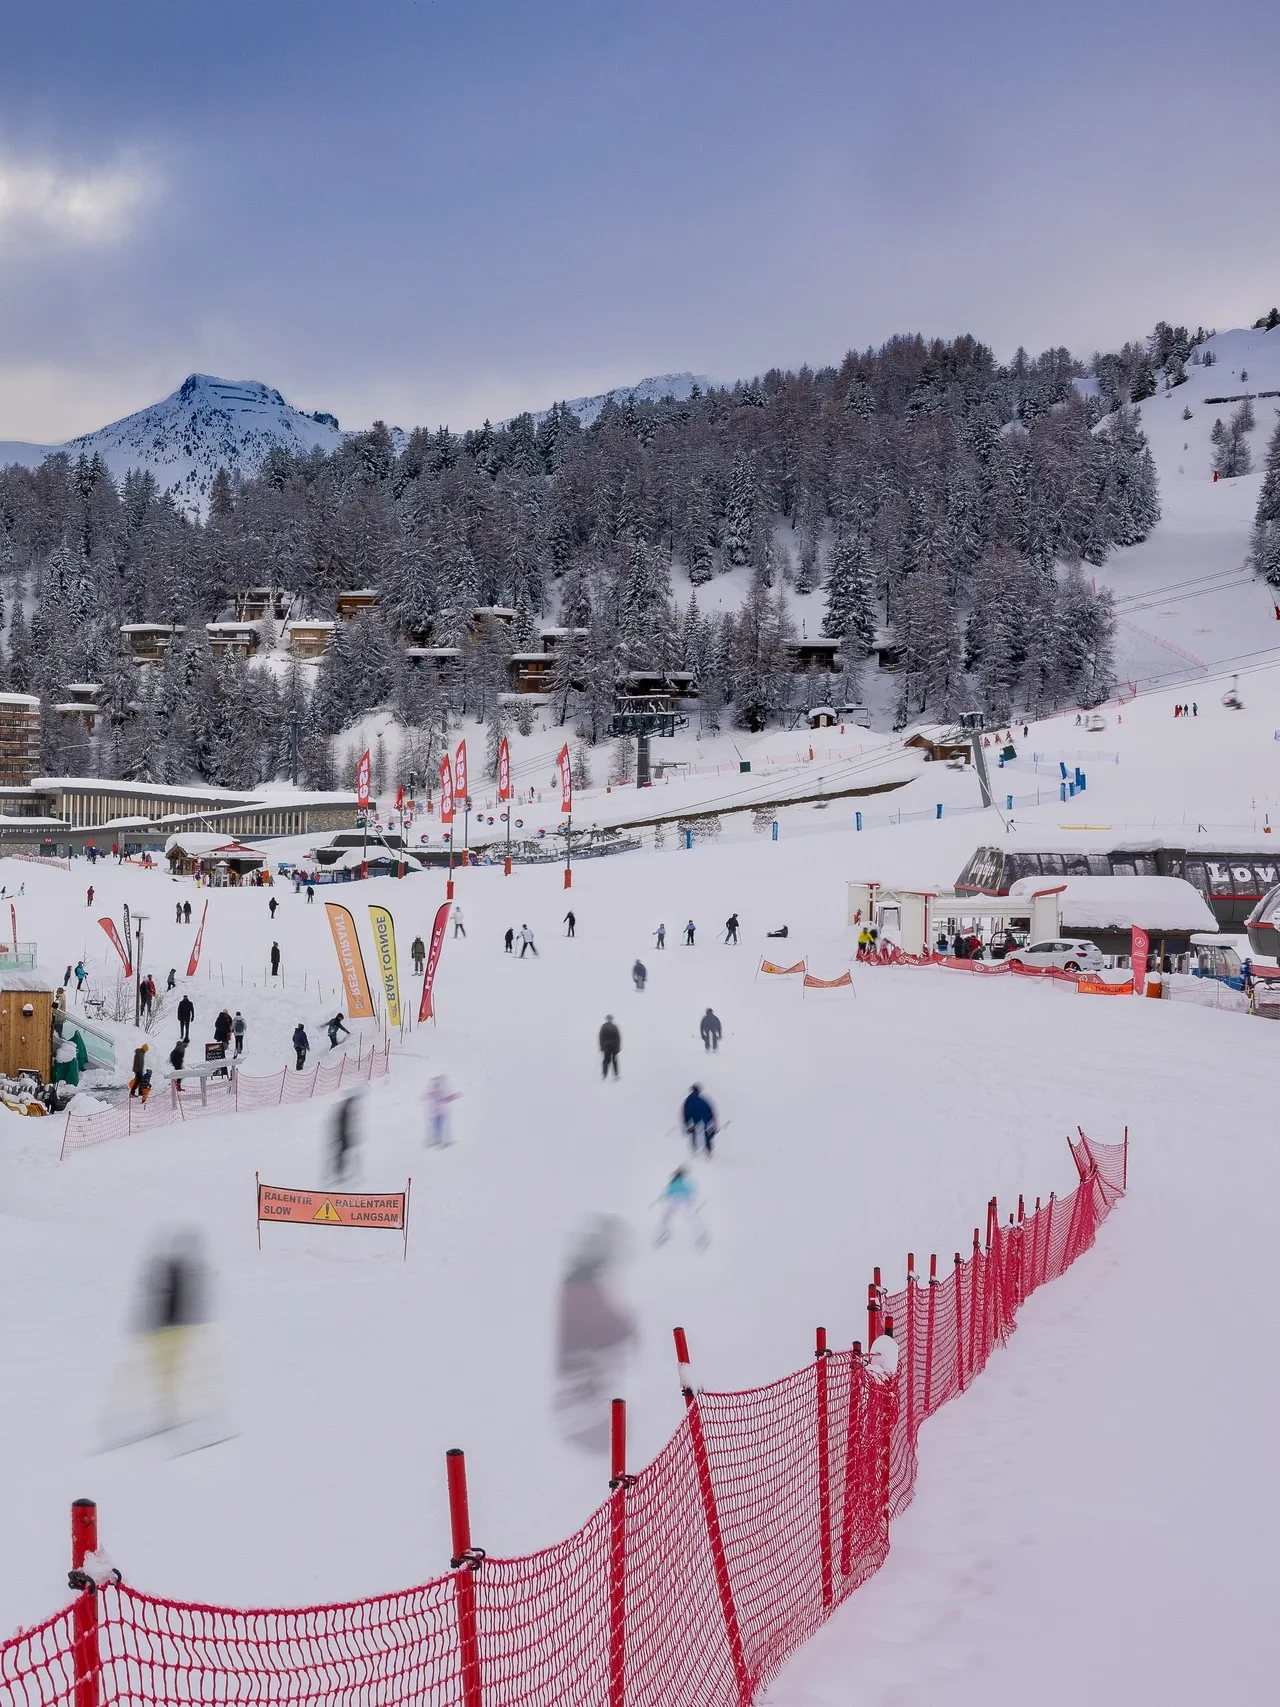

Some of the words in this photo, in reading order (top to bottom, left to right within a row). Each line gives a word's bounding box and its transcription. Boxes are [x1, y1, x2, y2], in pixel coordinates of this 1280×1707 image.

[425, 927, 442, 990] HOTEL
[1095, 985, 1124, 993] DANGER
[265, 1191, 313, 1205] RALENTIR
[335, 1199, 399, 1209] RALLENTARE
[264, 1205, 292, 1216] SLOW
[351, 1212, 399, 1223] LANGSAM
